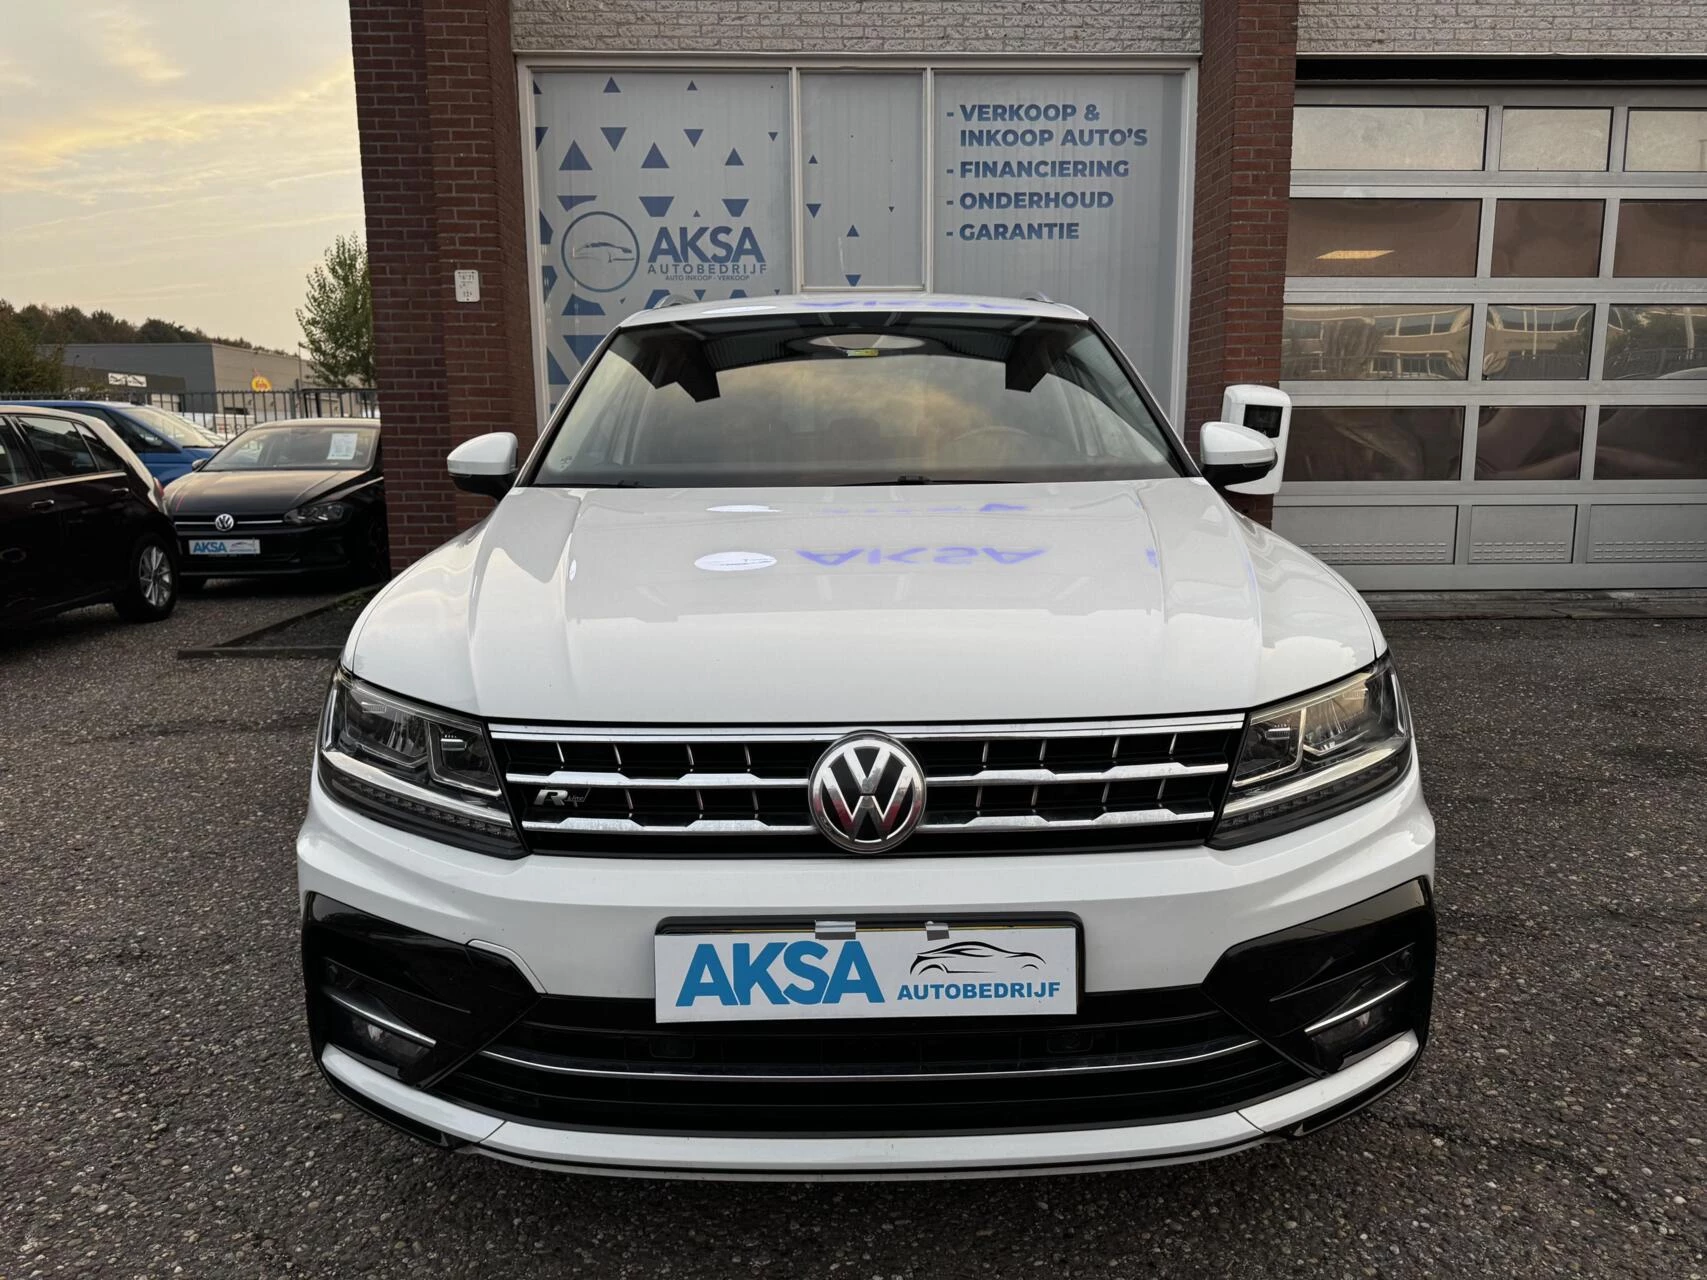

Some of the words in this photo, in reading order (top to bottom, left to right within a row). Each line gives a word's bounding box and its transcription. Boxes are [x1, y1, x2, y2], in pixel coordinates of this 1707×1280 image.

[960, 104, 1077, 122] VERKOOP
[1084, 104, 1100, 121] &
[960, 129, 1054, 147] INKOOP
[1060, 128, 1148, 146] AUTO'S
[960, 160, 1129, 178] FINANCIERING
[959, 191, 1114, 209] ONDERHOUD
[959, 222, 1079, 241] GARANTIE
[648, 226, 766, 264] AKSA
[648, 264, 767, 274] AUTOBEDRIJF
[193, 542, 227, 553] AKSA
[675, 940, 885, 1008] AKSA
[897, 982, 1061, 1001] AUTOBEDRIJF
